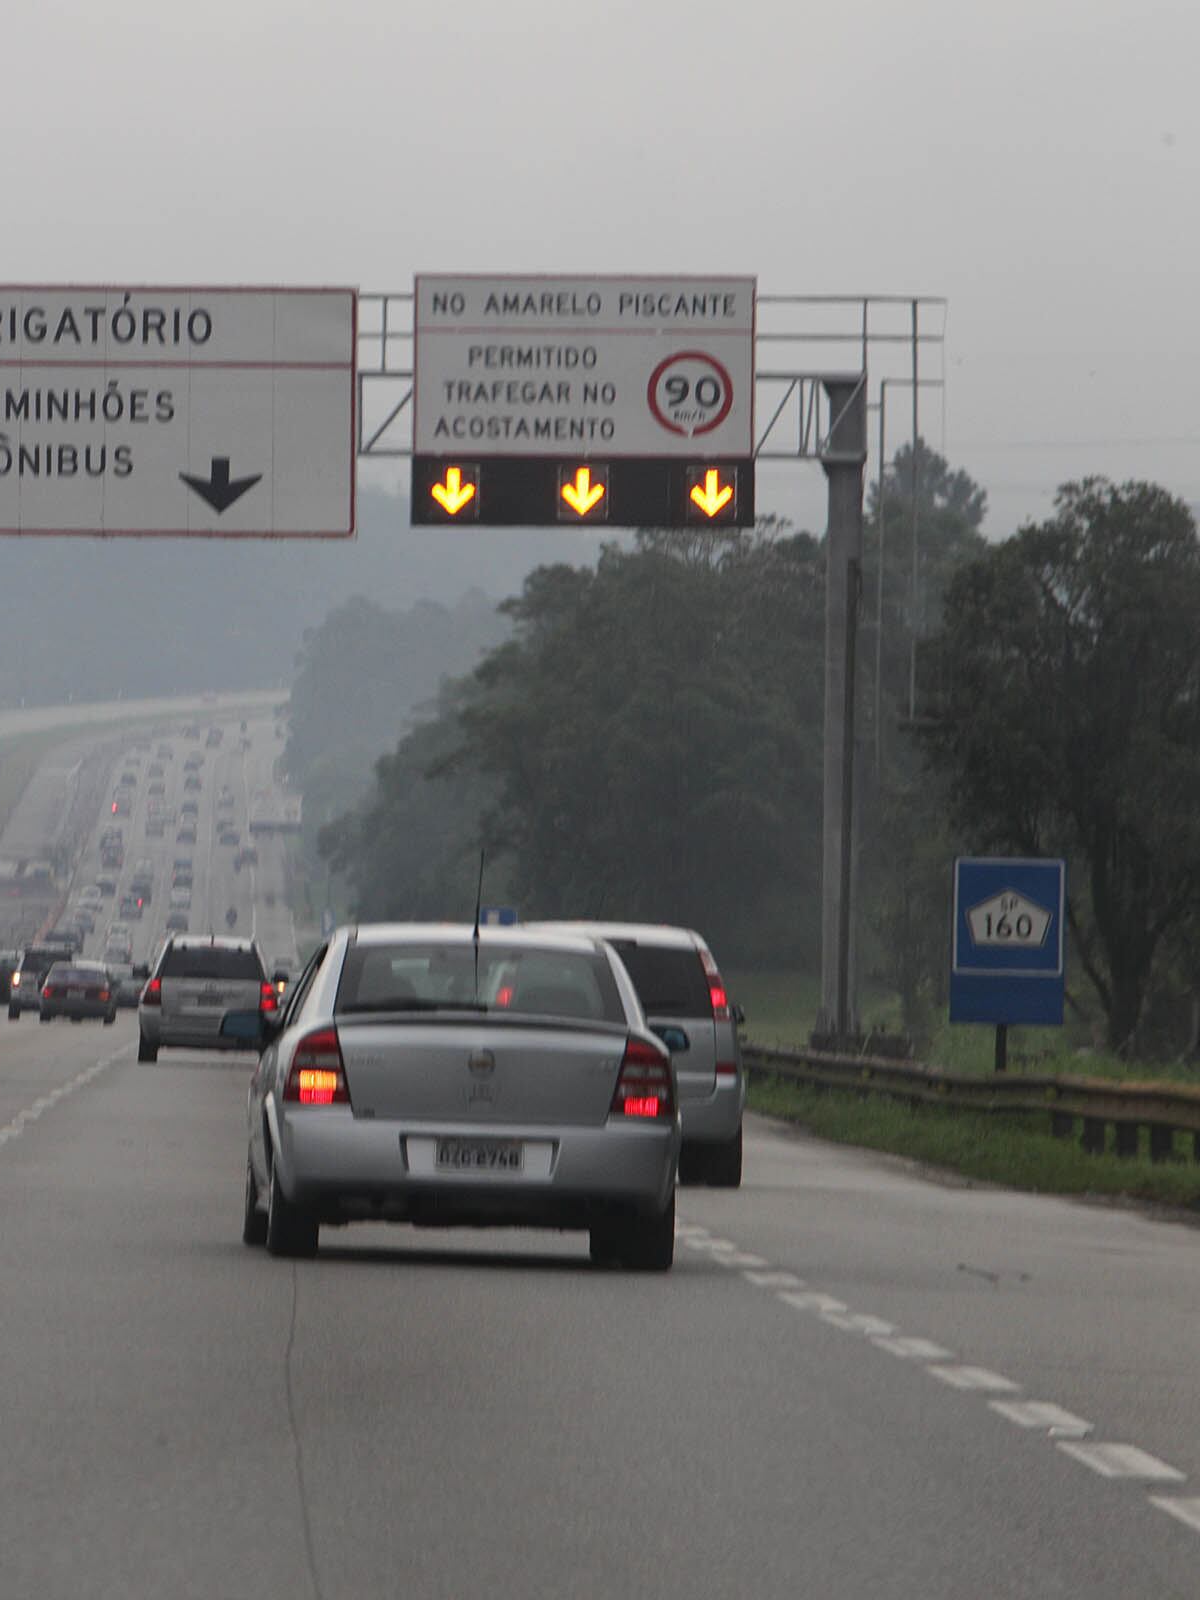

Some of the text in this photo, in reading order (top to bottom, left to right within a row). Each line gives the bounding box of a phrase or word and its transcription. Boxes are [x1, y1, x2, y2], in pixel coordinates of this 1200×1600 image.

[433, 293, 735, 316] NO AMARELO PISCANTE
[469, 346, 597, 368] PERMITIDO
[444, 381, 616, 404] TRAFEGAR NO
[664, 374, 721, 409] 90
[435, 416, 614, 440] ACOSTAMENTO
[986, 912, 1032, 938] 160
